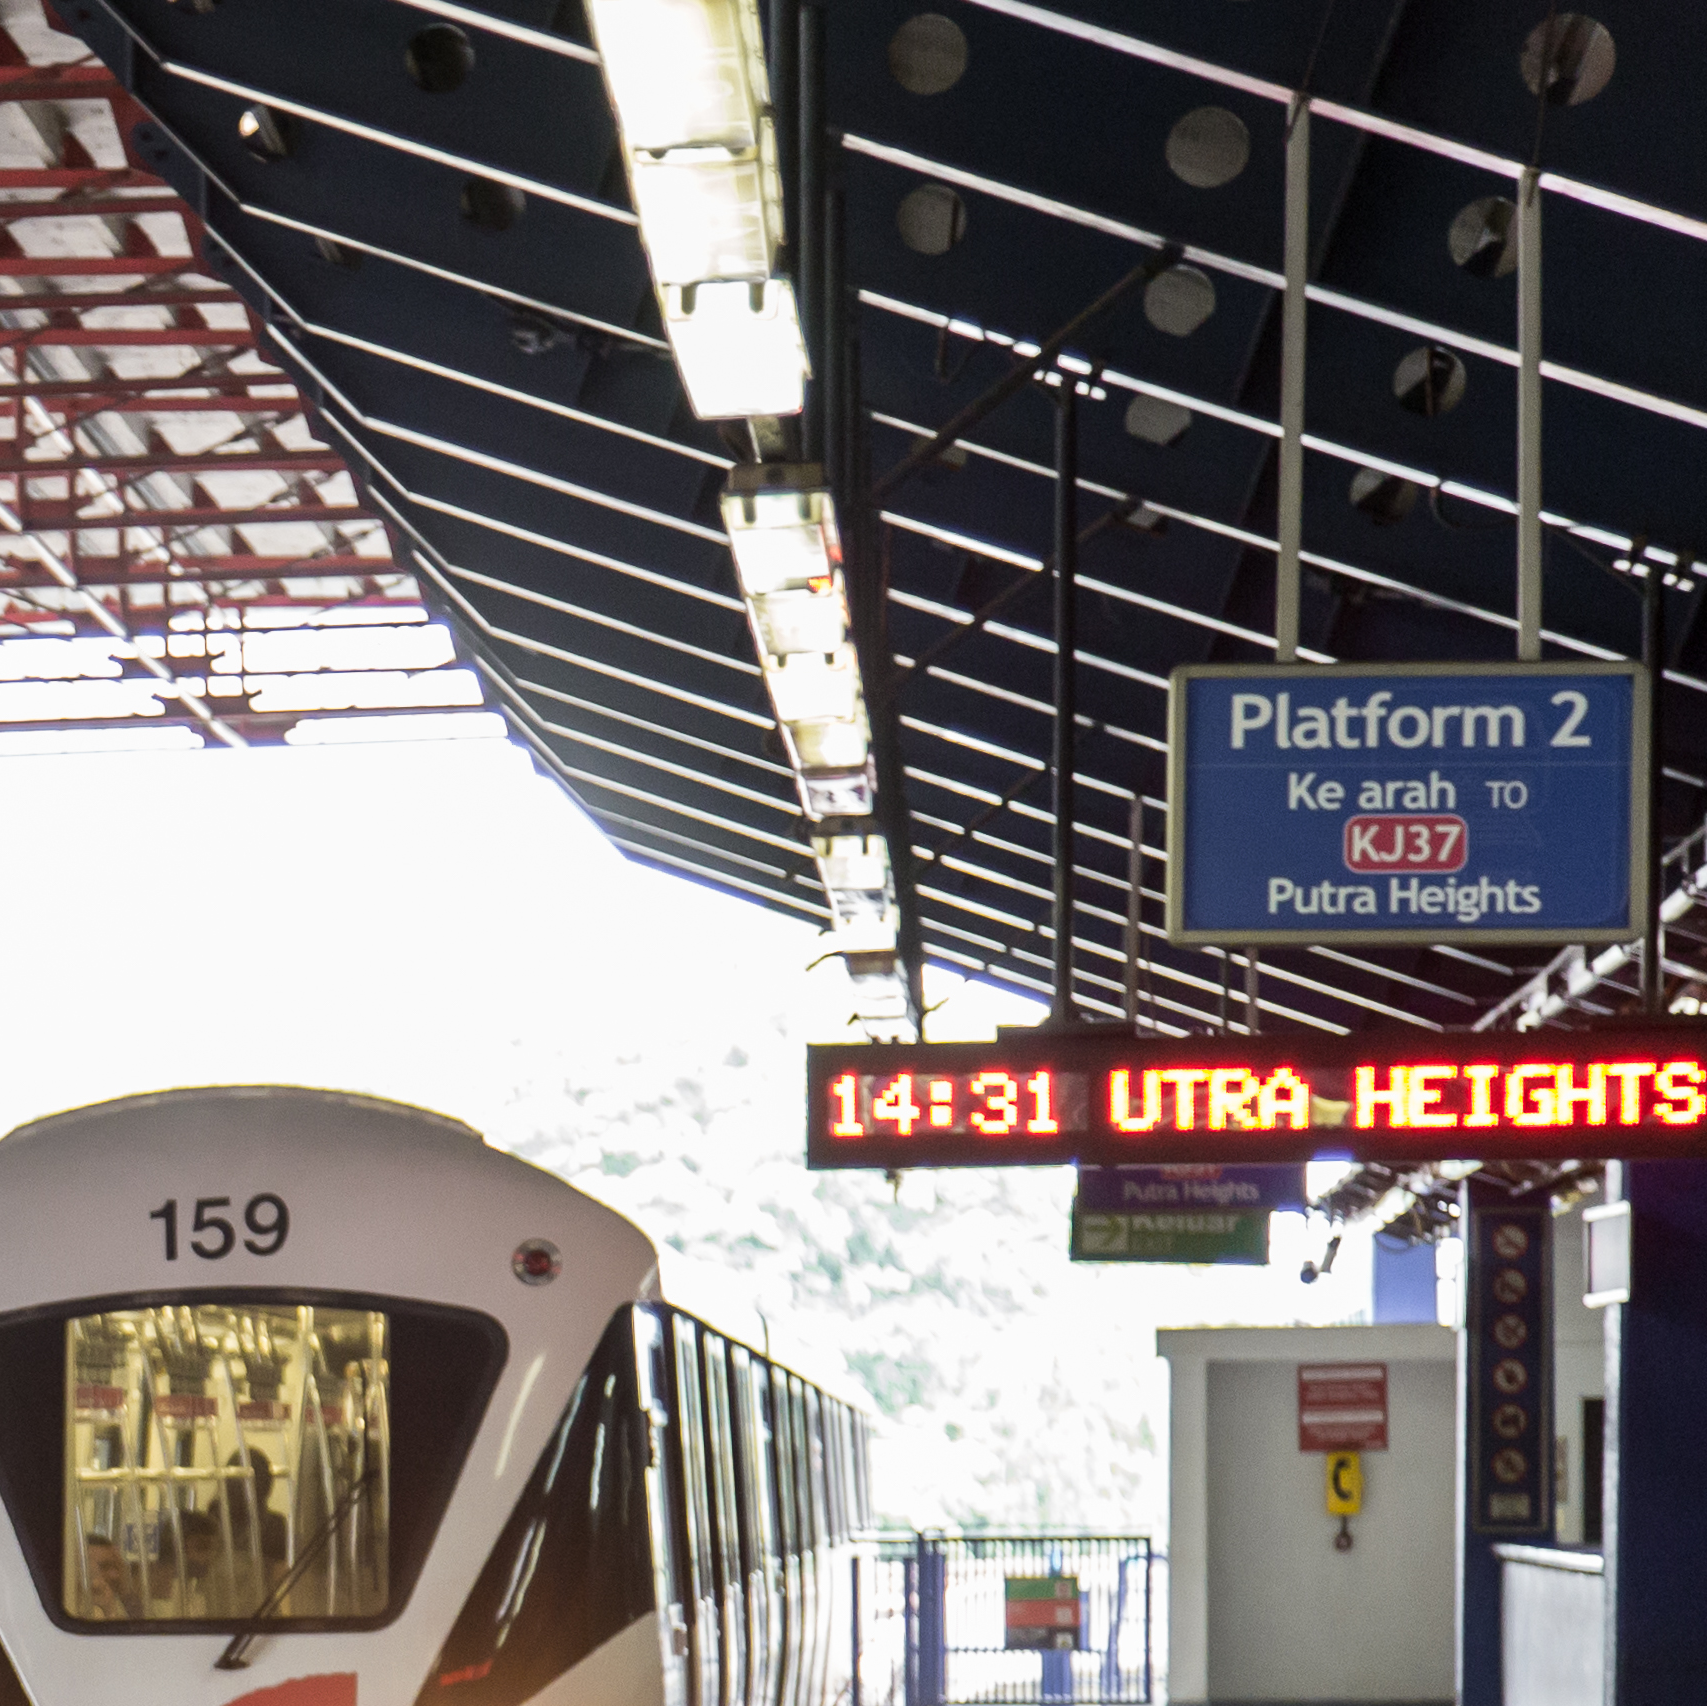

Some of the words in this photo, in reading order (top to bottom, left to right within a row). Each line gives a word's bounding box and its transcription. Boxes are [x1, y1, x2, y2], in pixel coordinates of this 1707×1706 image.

[1231, 692, 1526, 749] Platform
[1549, 690, 1591, 748] 2
[1288, 772, 1345, 810] Ke
[1358, 771, 1456, 810] arah
[1485, 780, 1528, 809] TO
[1350, 824, 1463, 863] KJ37
[1268, 877, 1377, 914] Putra
[1389, 875, 1542, 922] Heights
[831, 1070, 1059, 1137] 14:31
[1108, 1066, 1310, 1133] UTRA
[1353, 1060, 1707, 1130] HEIGHTS
[1124, 1179, 1179, 1201] Putra
[1184, 1179, 1260, 1205] Heights
[149, 1191, 290, 1262] 159
